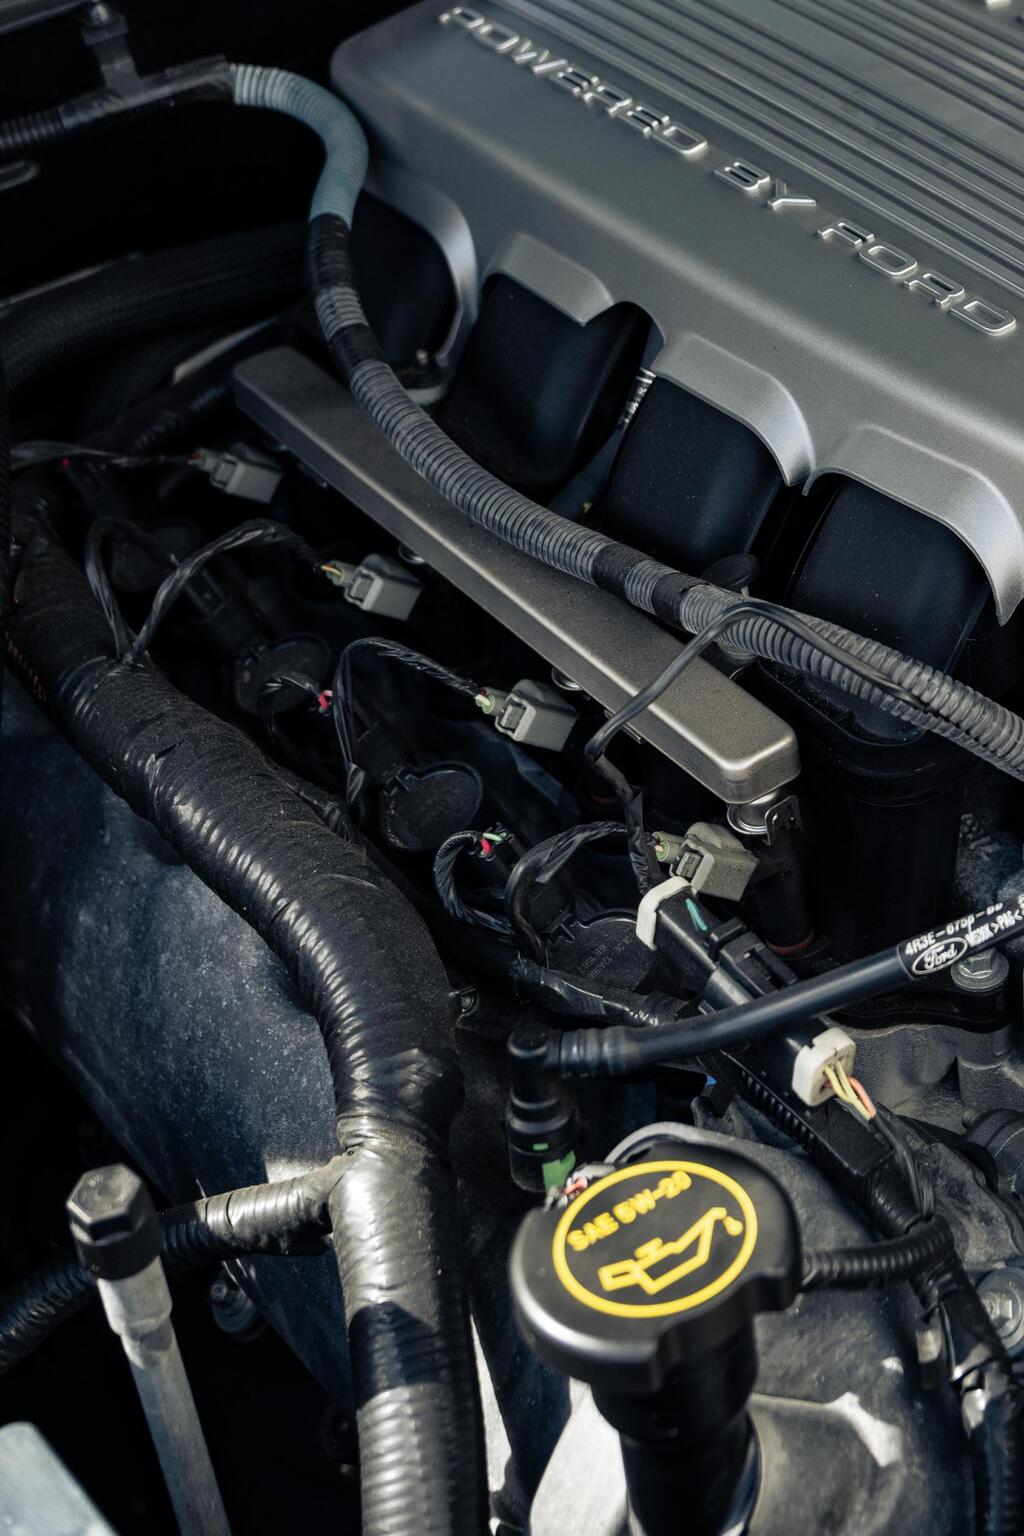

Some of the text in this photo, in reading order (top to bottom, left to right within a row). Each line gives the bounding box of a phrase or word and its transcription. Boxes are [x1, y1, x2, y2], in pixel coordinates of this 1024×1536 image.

[438, 5, 1017, 338] POWERED BY FORD
[922, 943, 958, 970] Ford
[566, 1170, 693, 1252] SAE 5W-20
